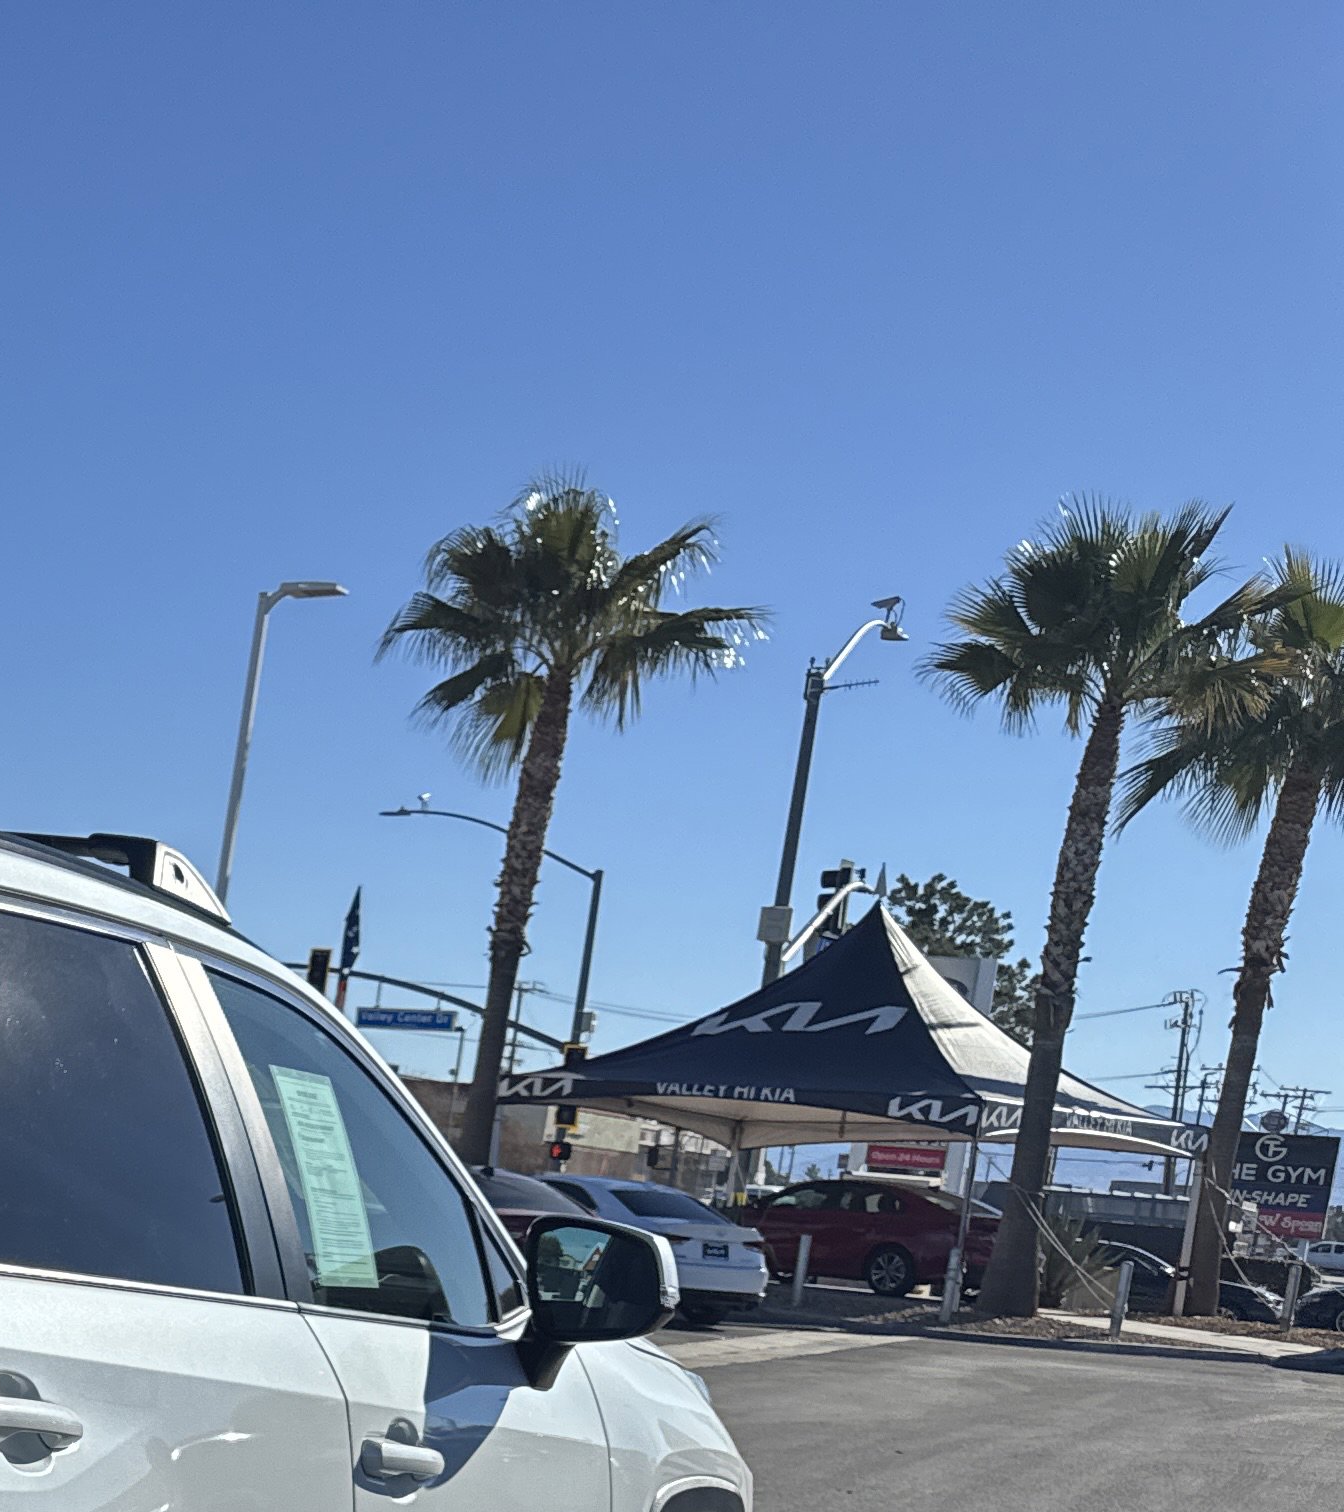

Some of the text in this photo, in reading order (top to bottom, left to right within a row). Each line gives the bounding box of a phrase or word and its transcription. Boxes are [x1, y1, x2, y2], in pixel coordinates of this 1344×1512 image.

[691, 1001, 909, 1035] KIA
[656, 1082, 796, 1102] VALLEY HI KIA
[887, 1096, 979, 1127] KIA
[1066, 1112, 1103, 1131] VALLEY
[1232, 1163, 1326, 1186] HE GYM
